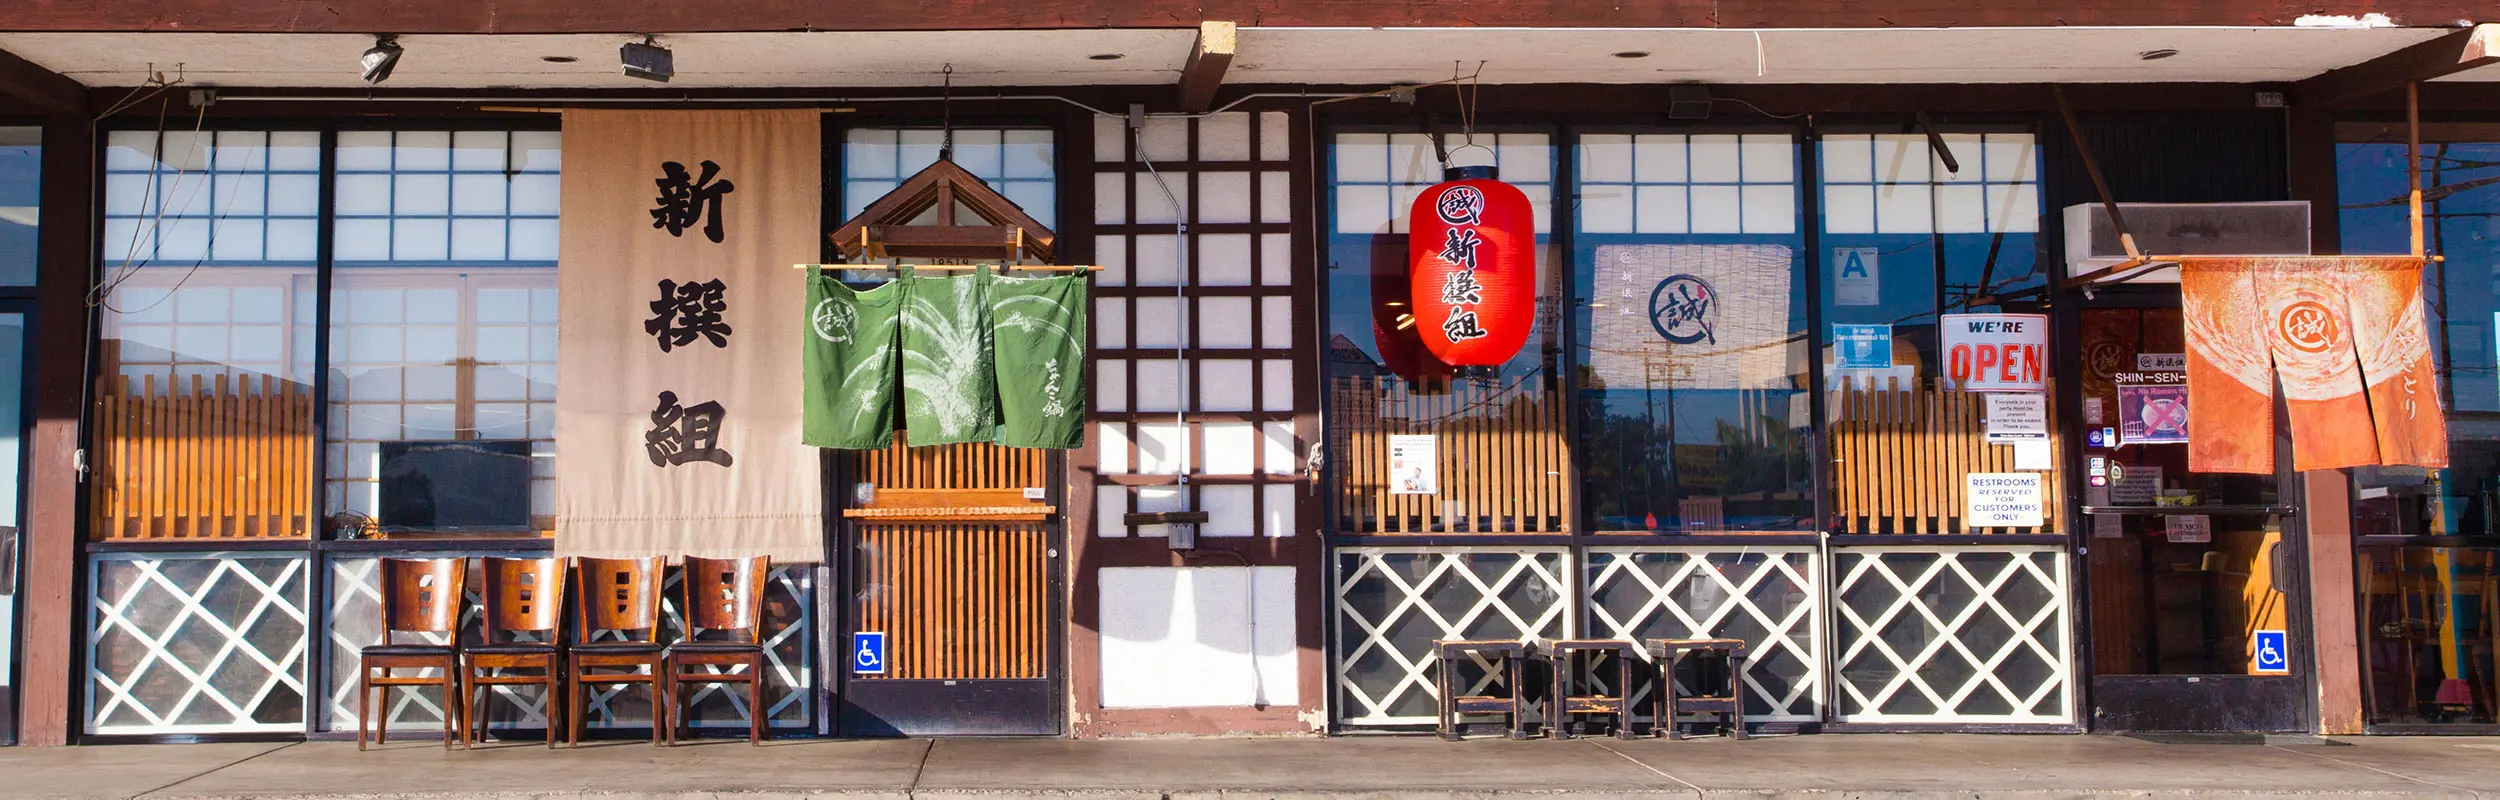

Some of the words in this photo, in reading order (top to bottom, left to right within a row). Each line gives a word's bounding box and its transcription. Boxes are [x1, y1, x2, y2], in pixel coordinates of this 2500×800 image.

[1842, 250, 1868, 278] A
[644, 159, 735, 469] 新撰組
[1949, 343, 2043, 383] OPEN
[1973, 478, 2036, 487] RESTROOMS
[1974, 504, 2037, 512] CUSTOMERS
